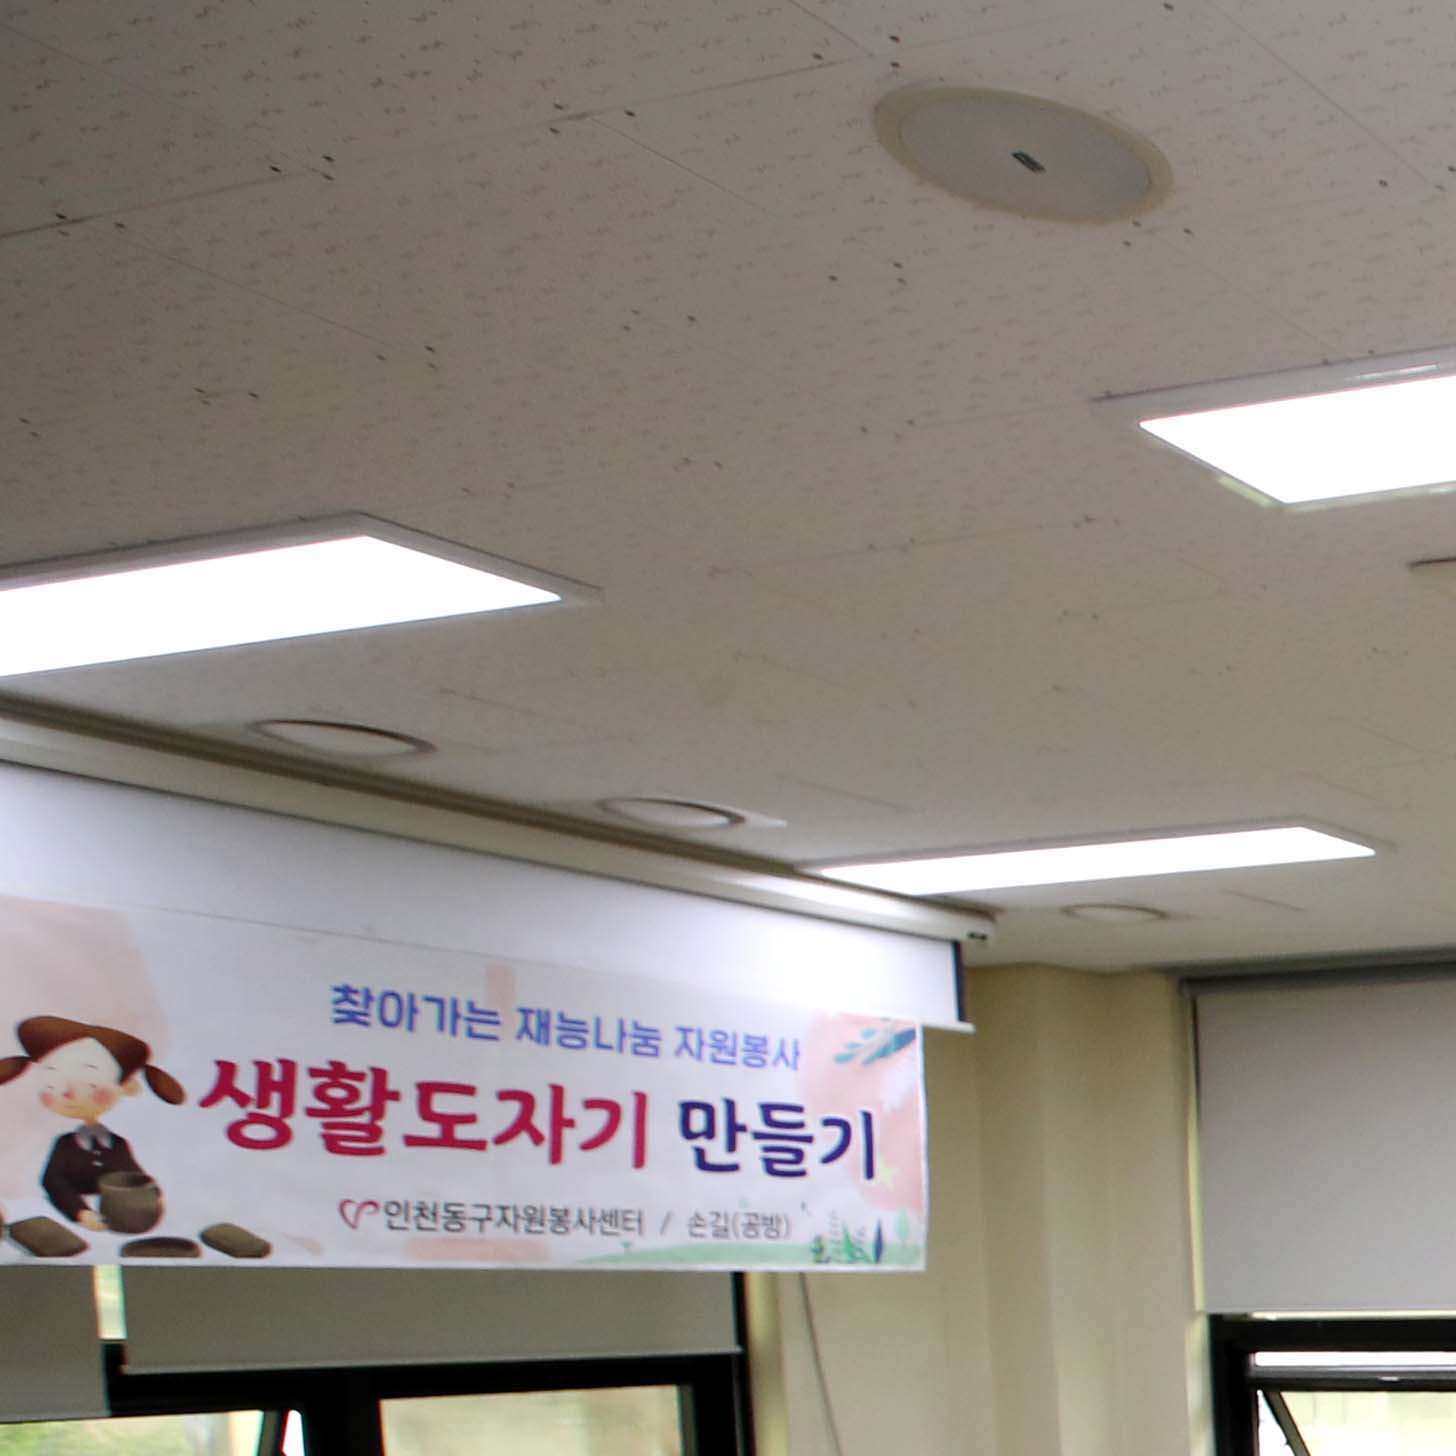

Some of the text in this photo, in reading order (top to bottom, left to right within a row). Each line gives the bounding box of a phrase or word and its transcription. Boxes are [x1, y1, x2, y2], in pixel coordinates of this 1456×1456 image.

[331, 983, 801, 1071] 찾아가는 재능나눔 자원봉사
[198, 1056, 875, 1180] 생활도자기 만들기
[382, 1199, 644, 1237] 인천동구자원봉사센터
[687, 1209, 791, 1240] 손길(공방)
